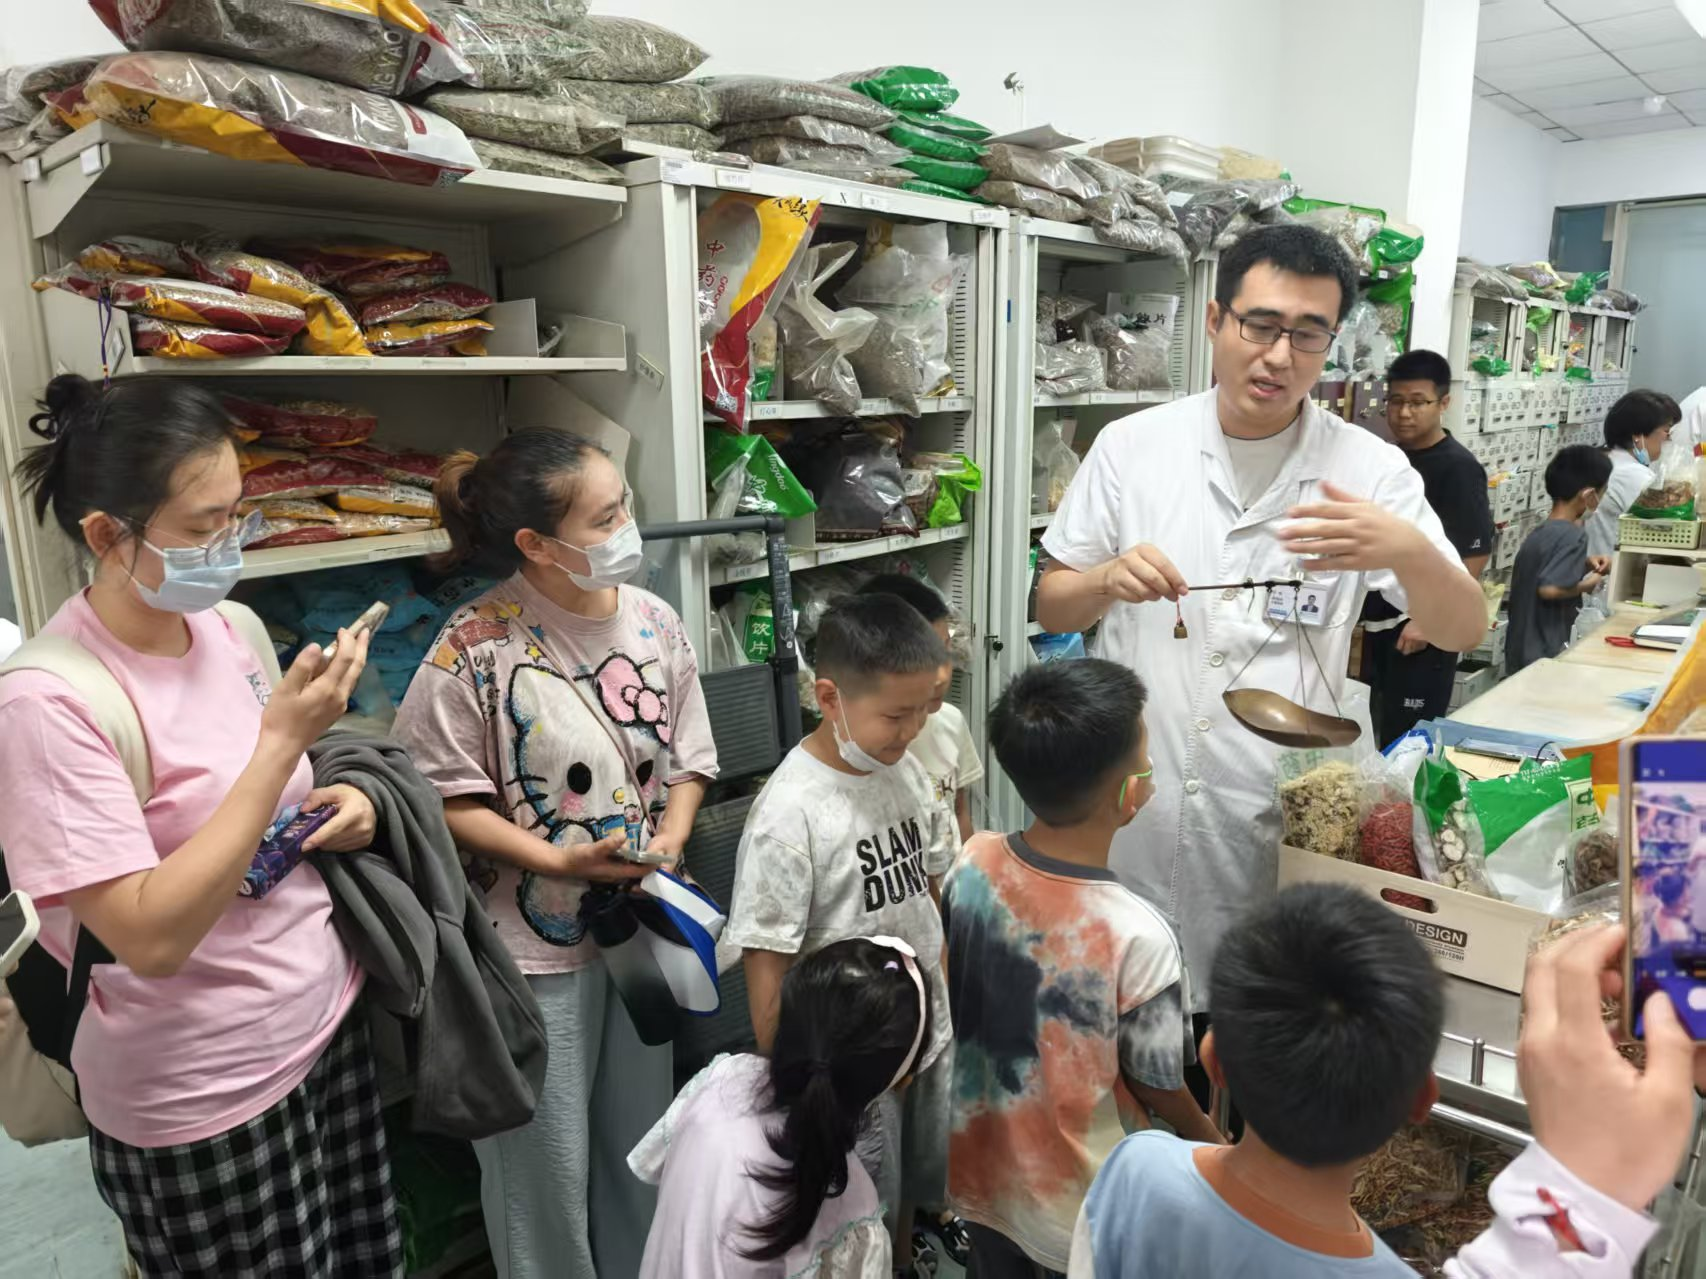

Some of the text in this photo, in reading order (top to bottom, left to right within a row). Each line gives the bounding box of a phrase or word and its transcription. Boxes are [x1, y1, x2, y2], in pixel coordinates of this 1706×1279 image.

[749, 622, 771, 655] 饮片
[855, 816, 922, 875] SLAM
[863, 851, 928, 912] DUNK
[1404, 919, 1464, 945] DESIGN
